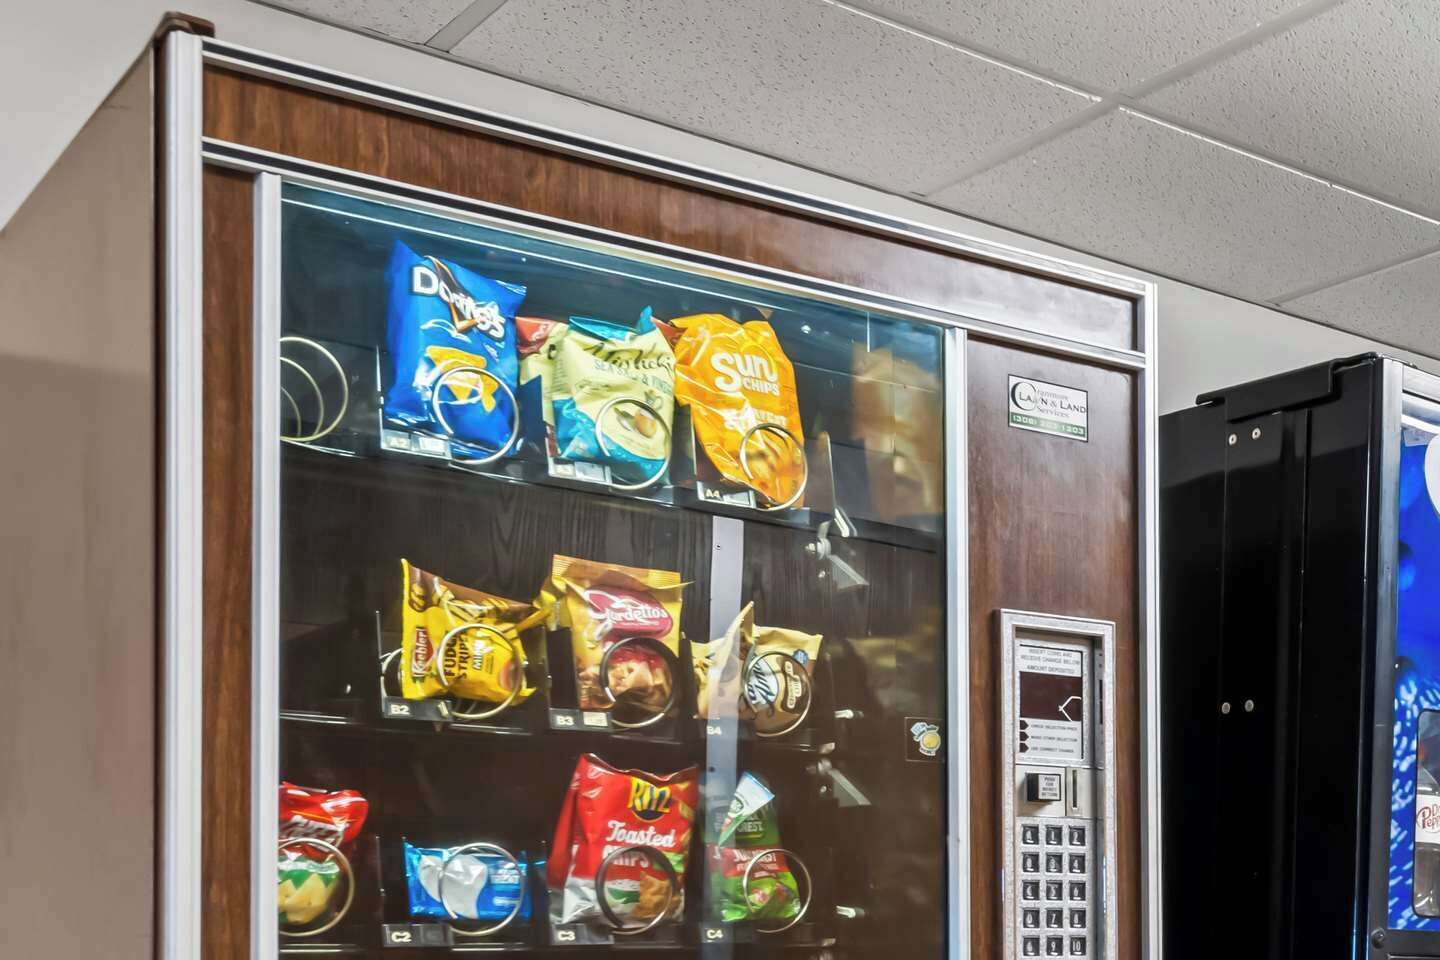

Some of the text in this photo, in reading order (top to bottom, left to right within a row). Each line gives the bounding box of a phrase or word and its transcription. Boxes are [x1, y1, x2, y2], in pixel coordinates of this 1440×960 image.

[711, 352, 779, 394] Sun
[740, 377, 780, 397] CHIPS
[412, 630, 427, 676] Keebler
[390, 703, 410, 715] B2
[556, 715, 574, 726] B3
[706, 726, 722, 736] B4
[606, 820, 676, 848] Toasted
[391, 931, 412, 943] C2
[558, 931, 576, 942] C3
[706, 929, 723, 940] C4
